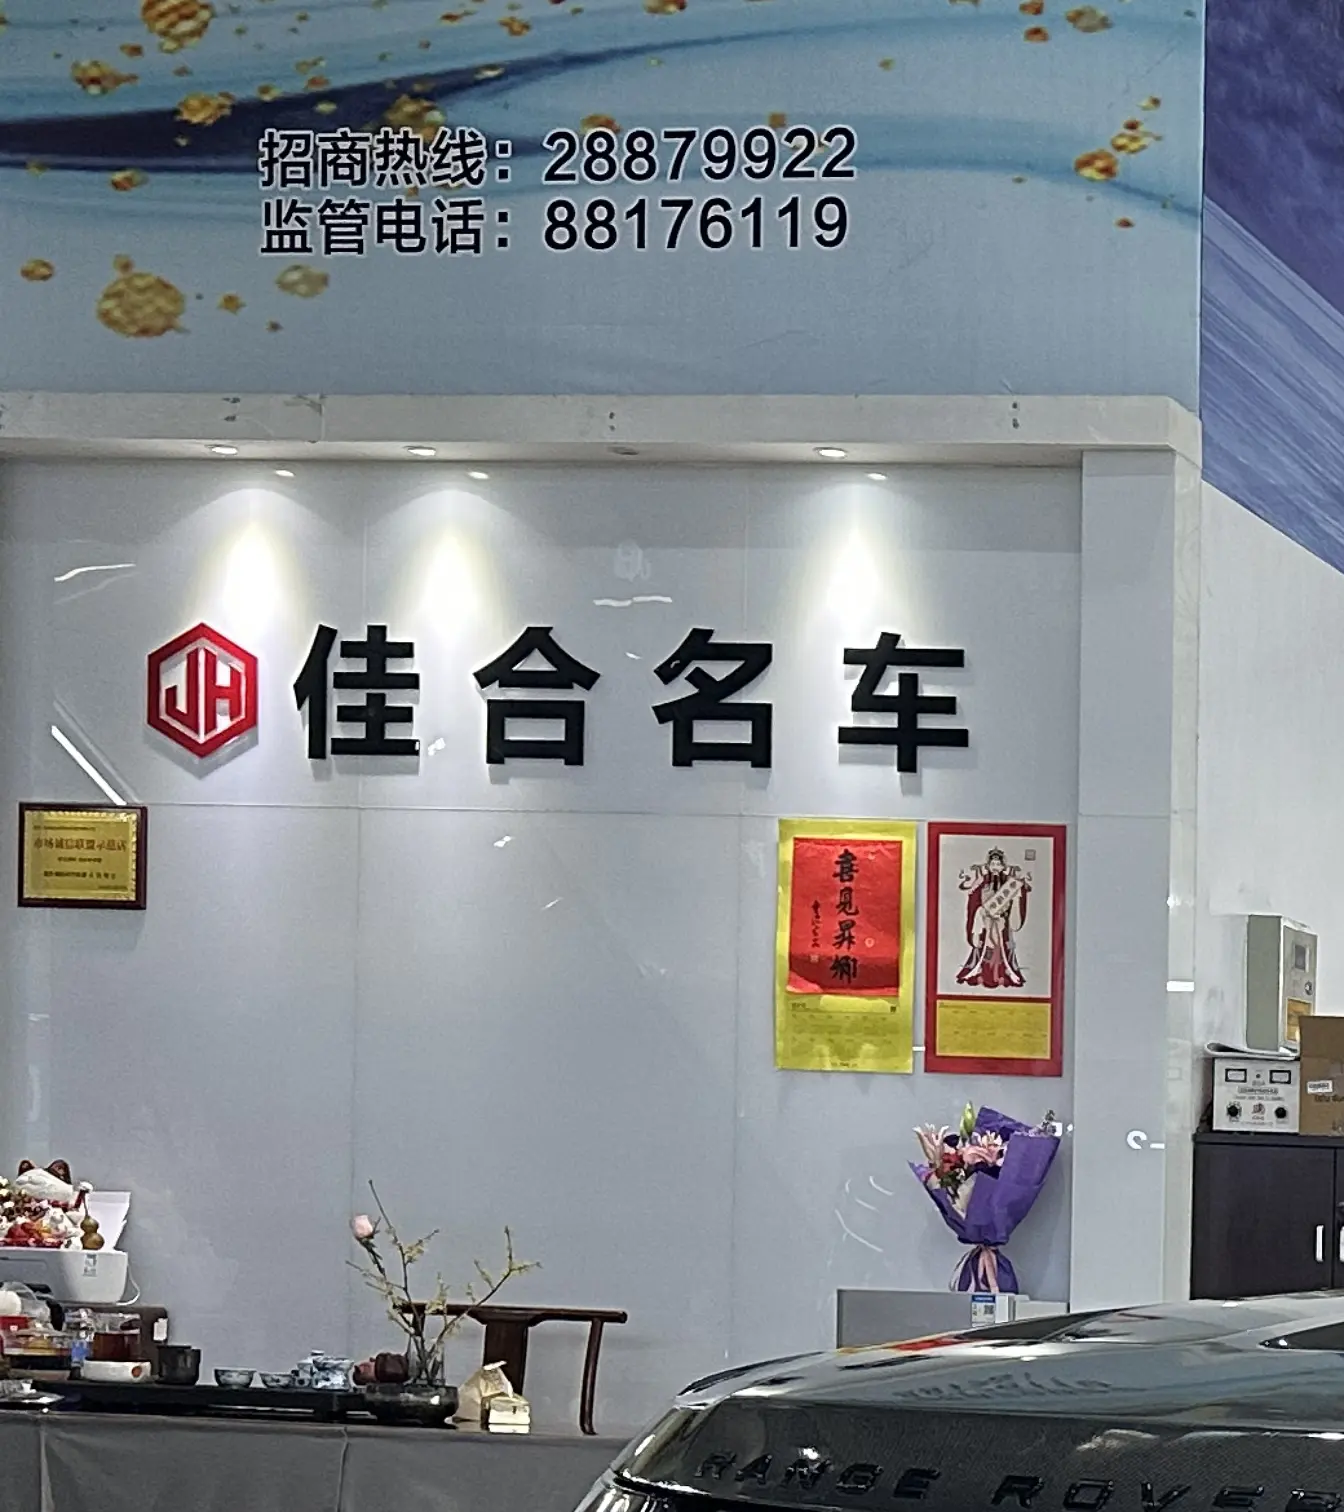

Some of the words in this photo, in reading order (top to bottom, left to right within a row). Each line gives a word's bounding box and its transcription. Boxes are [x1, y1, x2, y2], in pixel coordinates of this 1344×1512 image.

[543, 127, 857, 182] 28879922
[543, 196, 850, 251] 88176119
[293, 624, 971, 774] 佳合名车
[693, 1450, 941, 1501] RANGE
